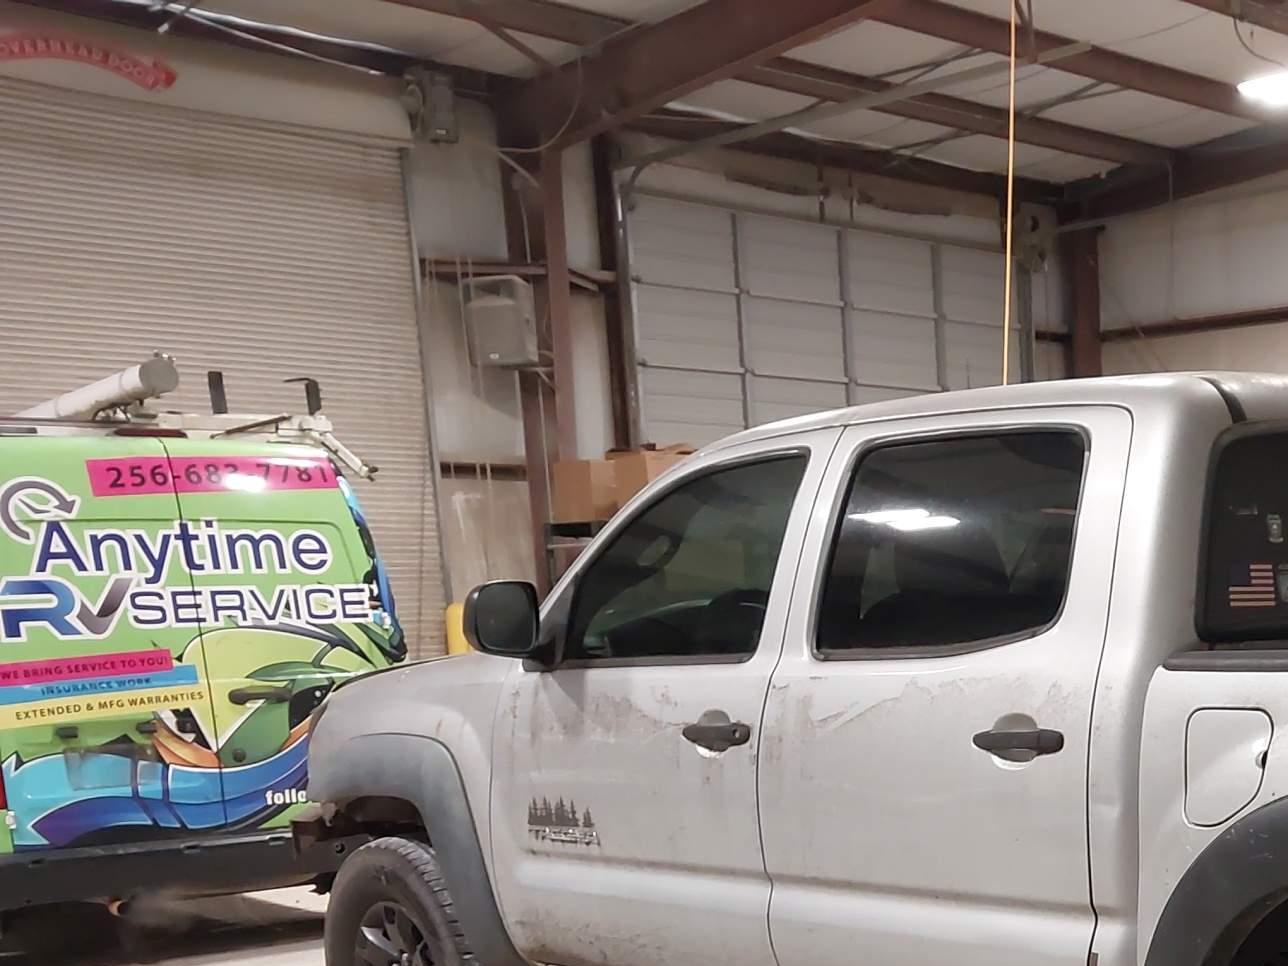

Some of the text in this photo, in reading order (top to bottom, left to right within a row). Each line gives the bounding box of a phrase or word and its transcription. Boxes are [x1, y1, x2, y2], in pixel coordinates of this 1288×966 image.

[35, 520, 328, 583] Anytime
[1, 580, 369, 637] RV SERVICE
[1, 656, 168, 680] WE BRING SERVICE TO YOU!
[41, 677, 152, 696] INSURANCE WORK
[15, 691, 204, 720] EXTENDED & MFG WARRANTIES
